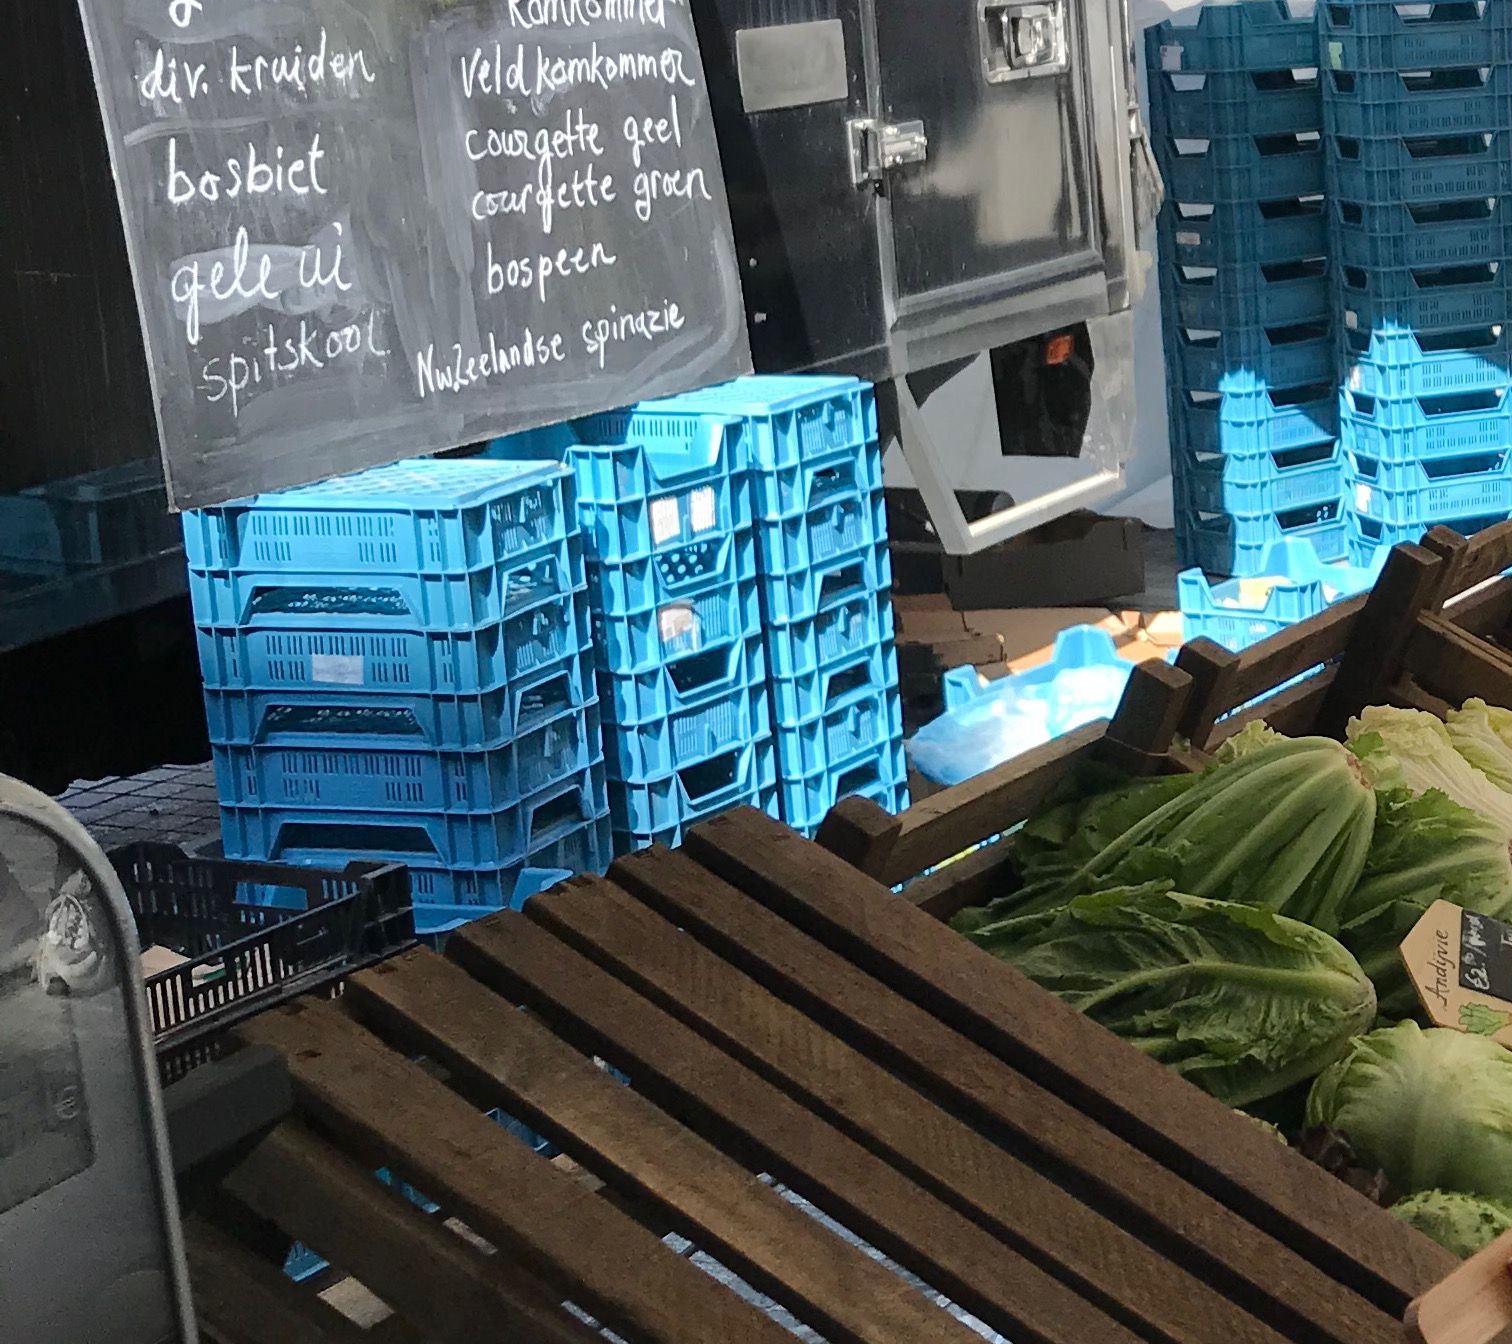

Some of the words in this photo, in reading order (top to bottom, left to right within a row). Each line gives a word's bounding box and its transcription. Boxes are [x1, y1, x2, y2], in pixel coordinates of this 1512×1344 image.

[230, 26, 376, 95] kruiden
[167, 133, 328, 205] bosbiet
[465, 108, 604, 186] courgette
[623, 94, 682, 168] geel
[472, 163, 616, 233] courgette
[634, 167, 712, 221] groen
[171, 225, 285, 345] gele
[487, 241, 616, 303] bospeen
[582, 298, 686, 369] spinazie
